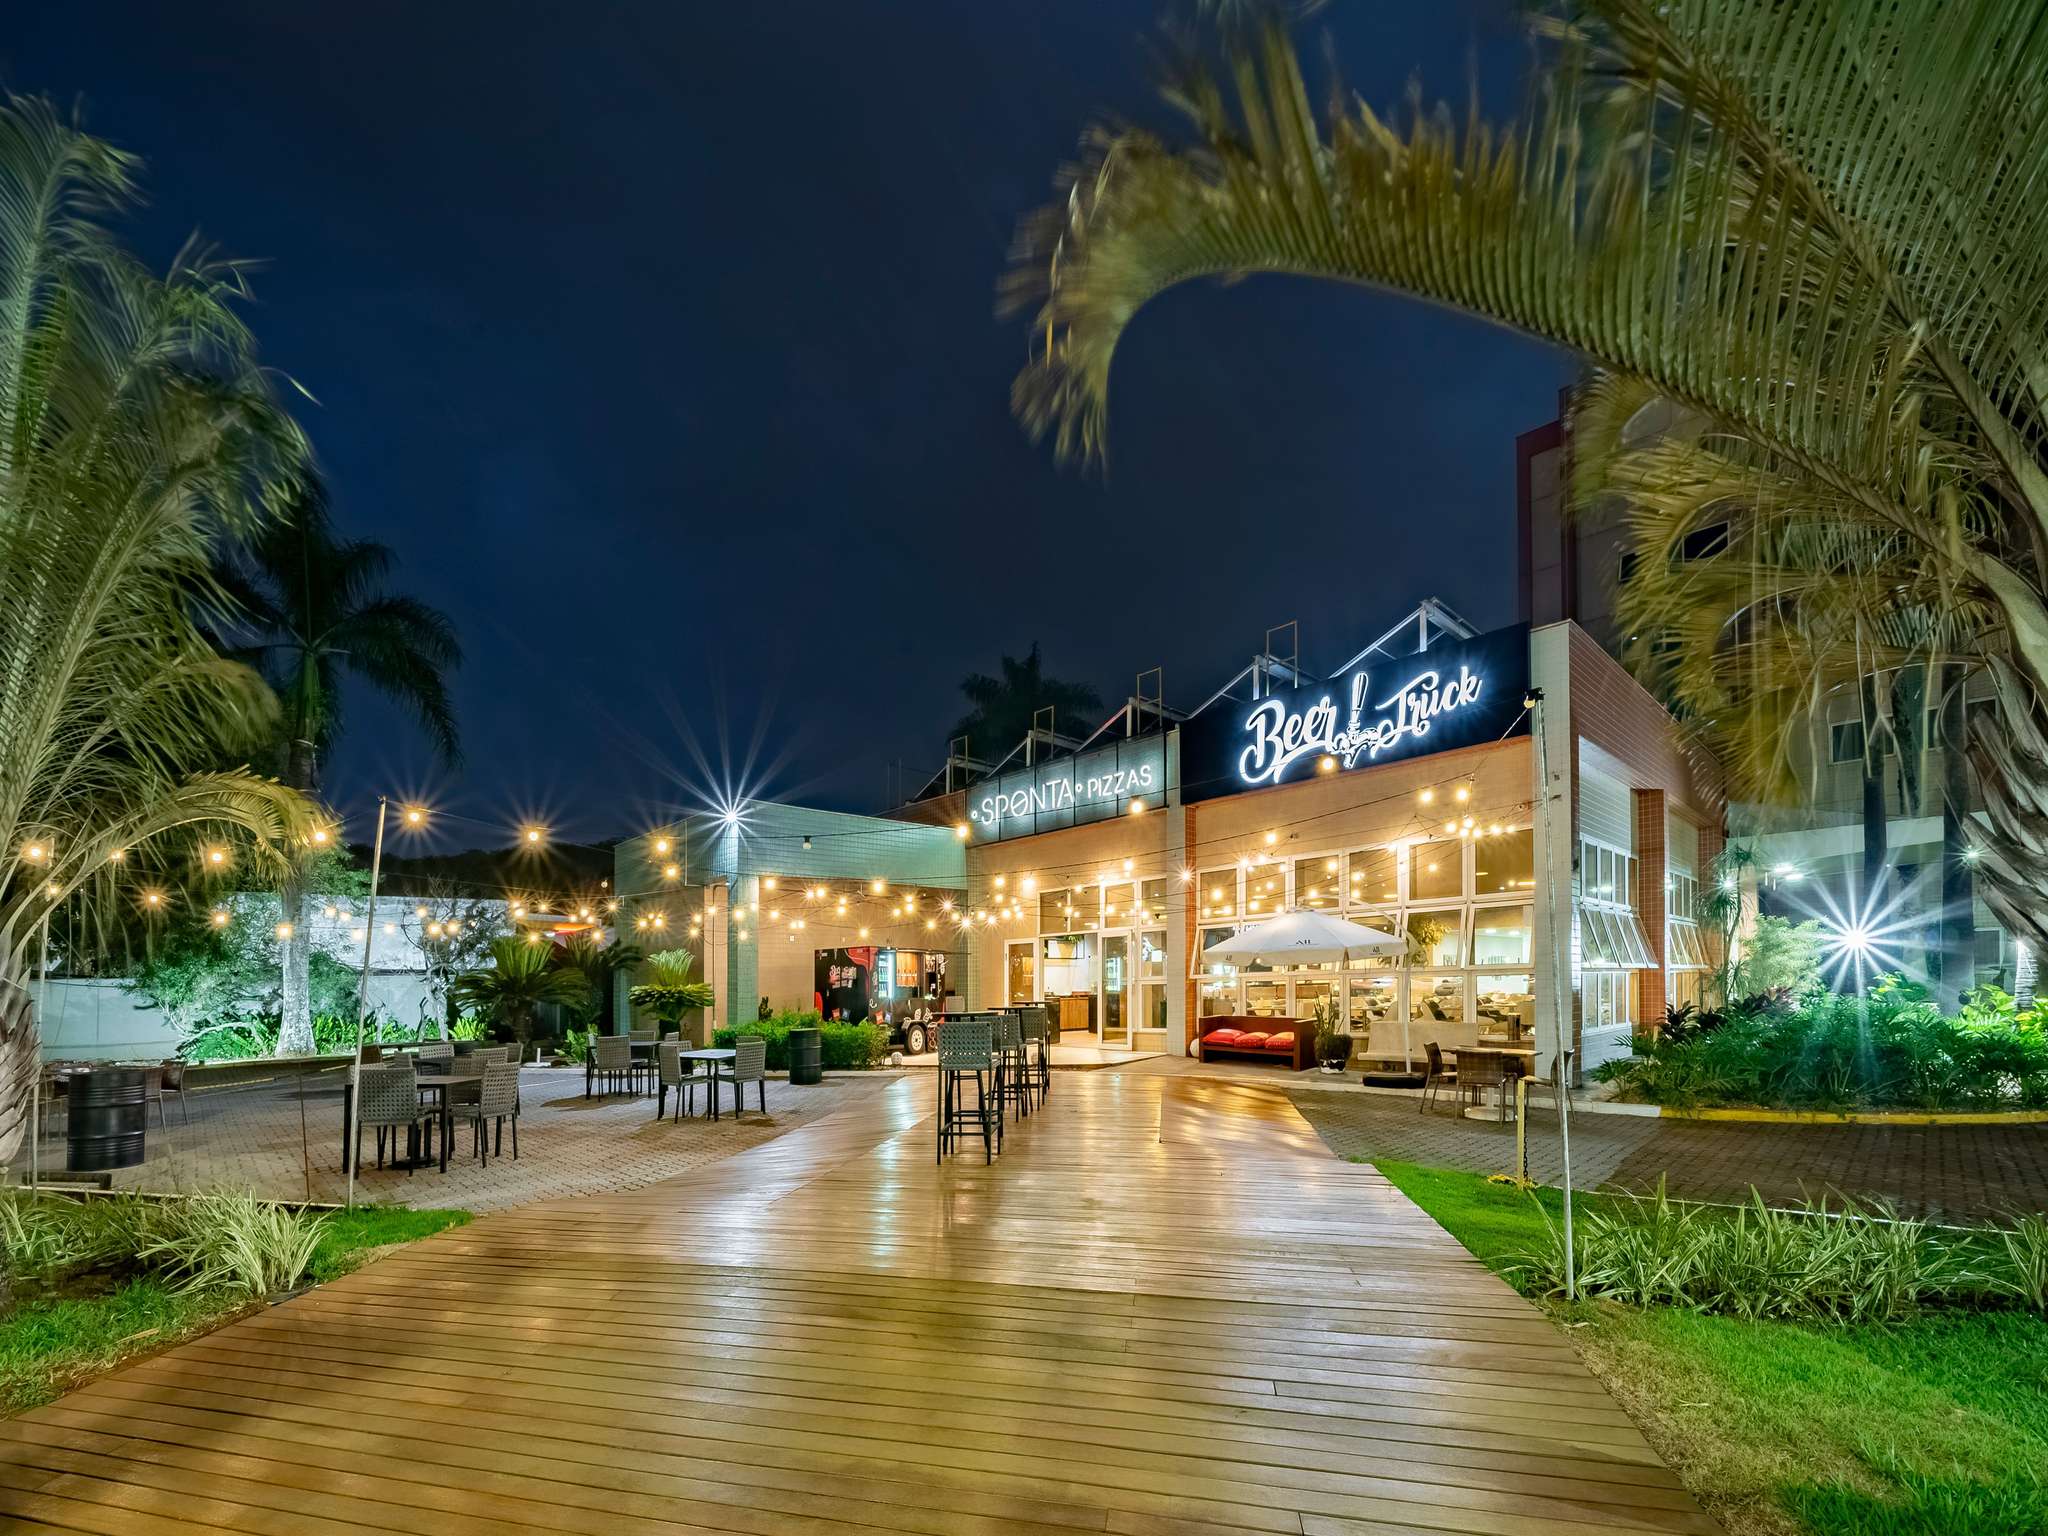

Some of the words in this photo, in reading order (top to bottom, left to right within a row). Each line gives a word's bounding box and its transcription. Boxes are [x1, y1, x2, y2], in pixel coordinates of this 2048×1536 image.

[1239, 696, 1337, 783] Beer
[1373, 666, 1483, 748] Truck
[1087, 765, 1152, 798] PIZZAS
